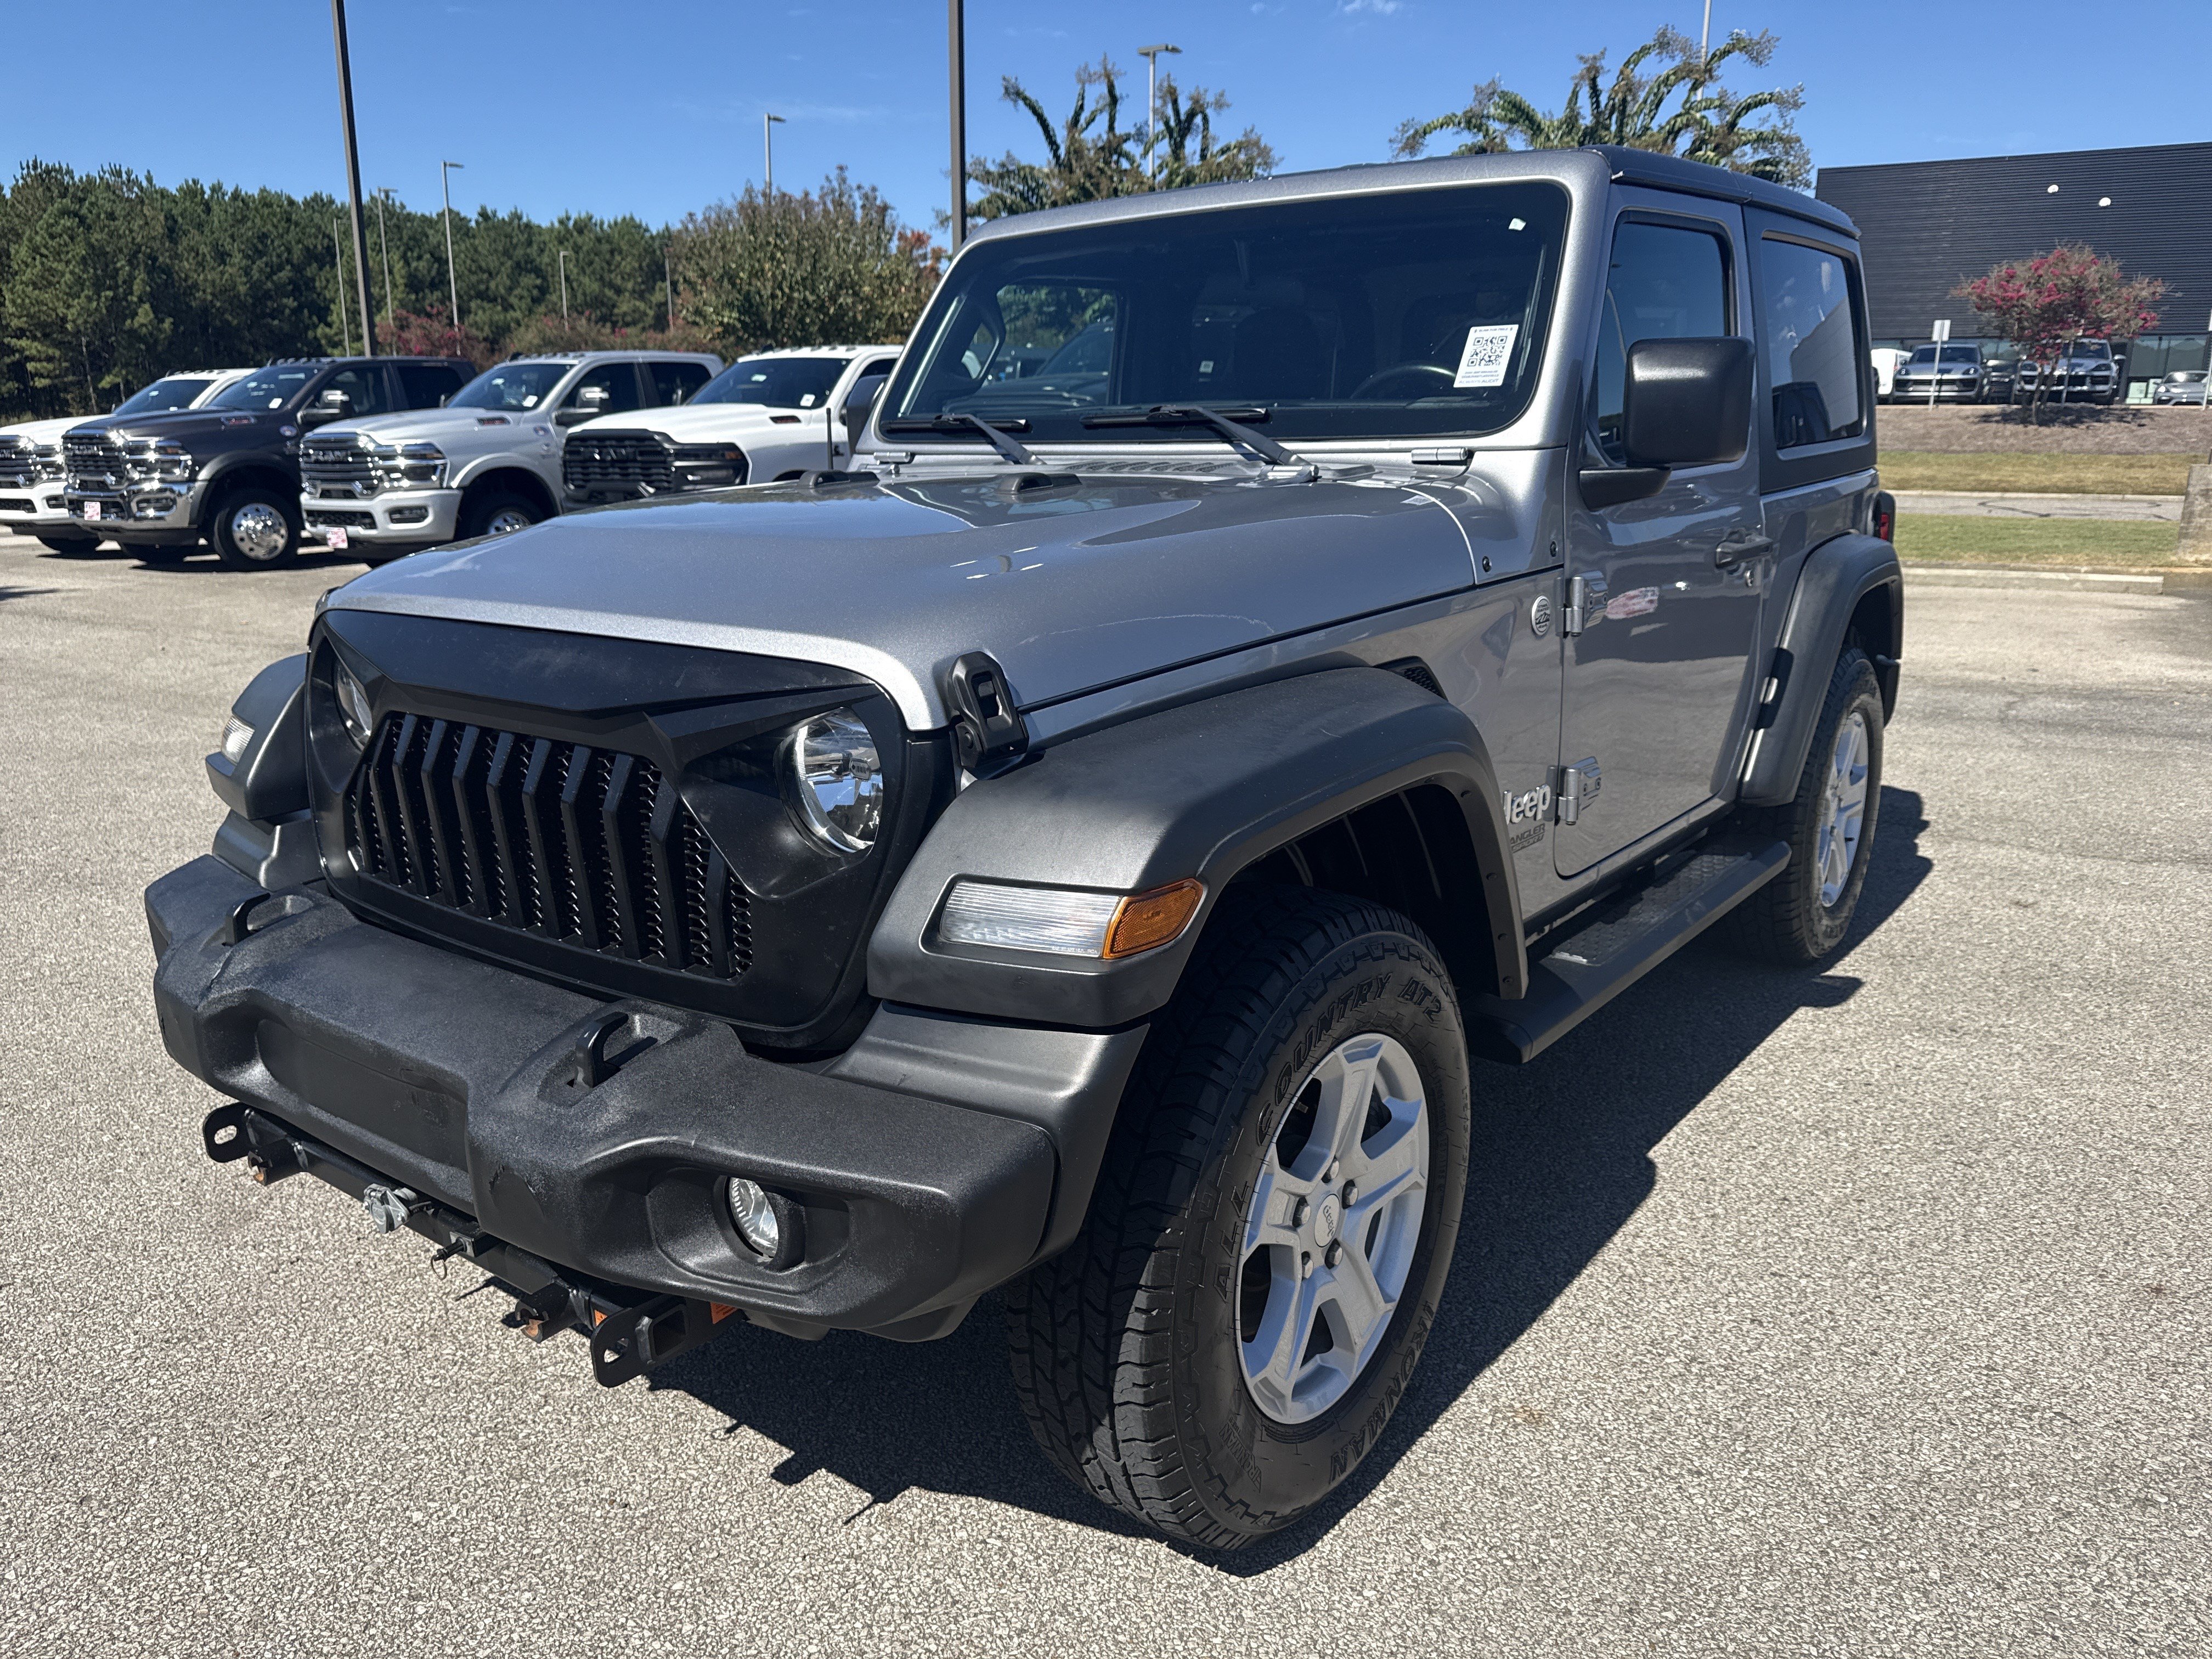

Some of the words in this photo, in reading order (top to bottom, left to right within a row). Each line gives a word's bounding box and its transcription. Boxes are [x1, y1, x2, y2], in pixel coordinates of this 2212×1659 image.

[1504, 783, 1551, 825] Jeep
[1509, 823, 1545, 844] ANGLER
[1214, 1181, 1249, 1304] ALL
[1256, 972, 1393, 1147] COUNTRY
[1397, 977, 1442, 1024] AT2
[1323, 1205, 1335, 1237] Jeep
[1328, 1300, 1435, 1485] IRONMAN
[1218, 1421, 1261, 1488] IRONMAN
